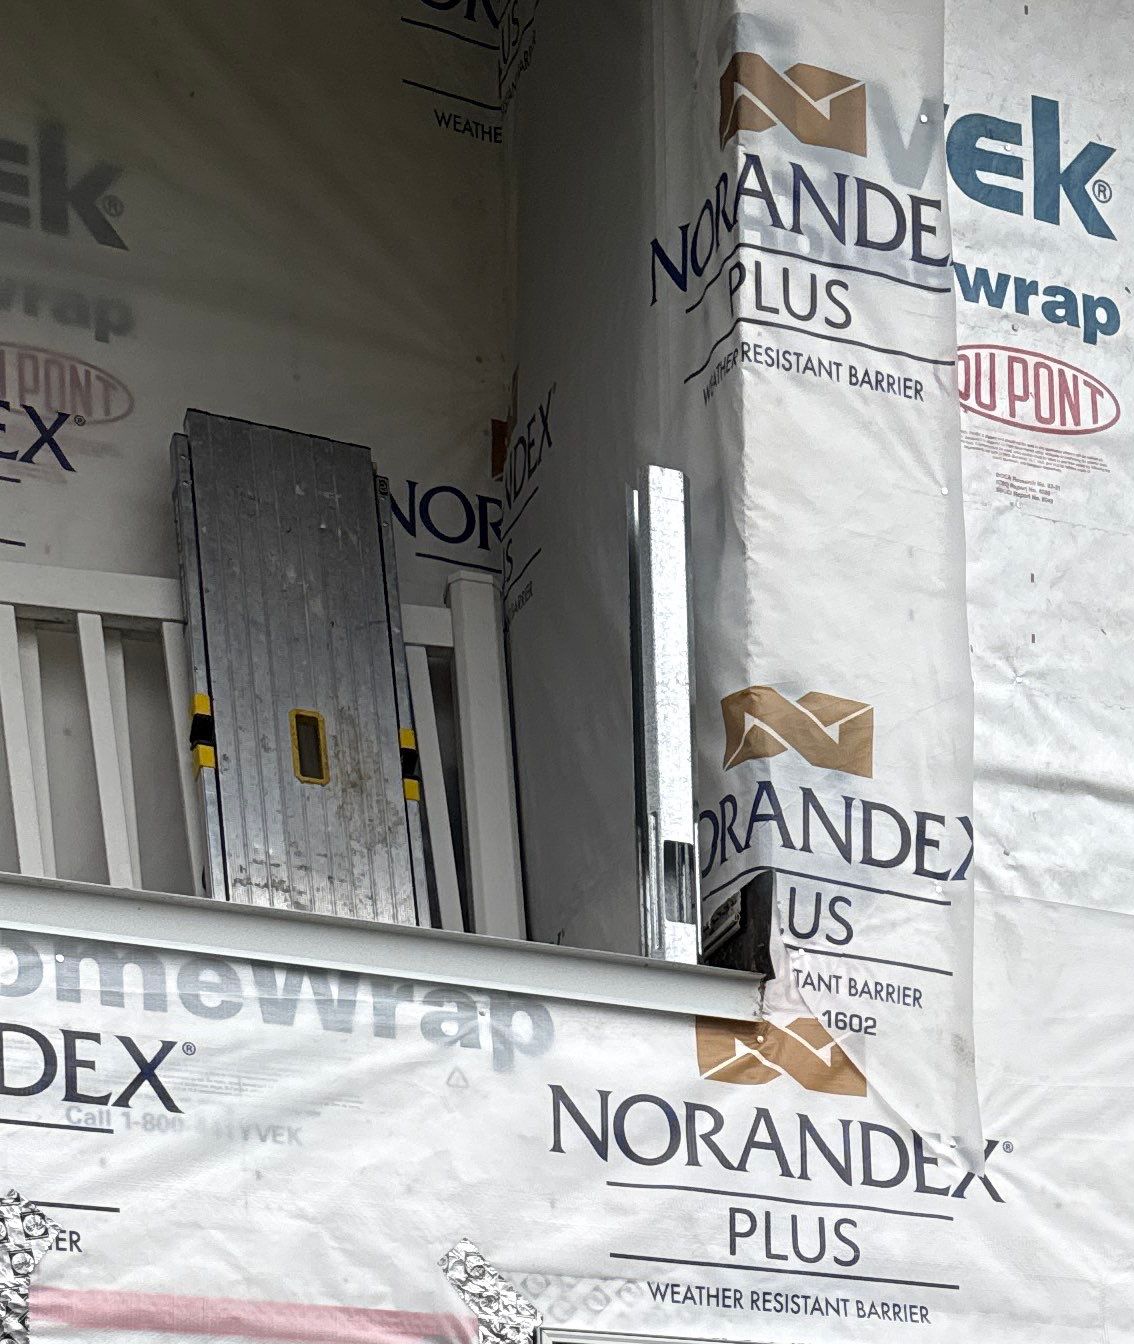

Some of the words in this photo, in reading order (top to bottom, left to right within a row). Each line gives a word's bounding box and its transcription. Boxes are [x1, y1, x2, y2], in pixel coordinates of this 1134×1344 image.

[650, 152, 952, 307] NORANDE
[728, 260, 852, 332] PLUS
[740, 341, 843, 384] RESISTANT
[848, 364, 925, 403] BARRIER
[1007, 357, 1106, 428] PONT
[780, 886, 853, 946] US
[821, 1008, 878, 1037] 1602
[848, 976, 923, 1009] BARRIER
[728, 1206, 861, 1267] PLUS
[647, 1280, 744, 1310] WEATHER
[750, 1290, 851, 1319] RESISTANT
[855, 1299, 932, 1325] BARRIER
